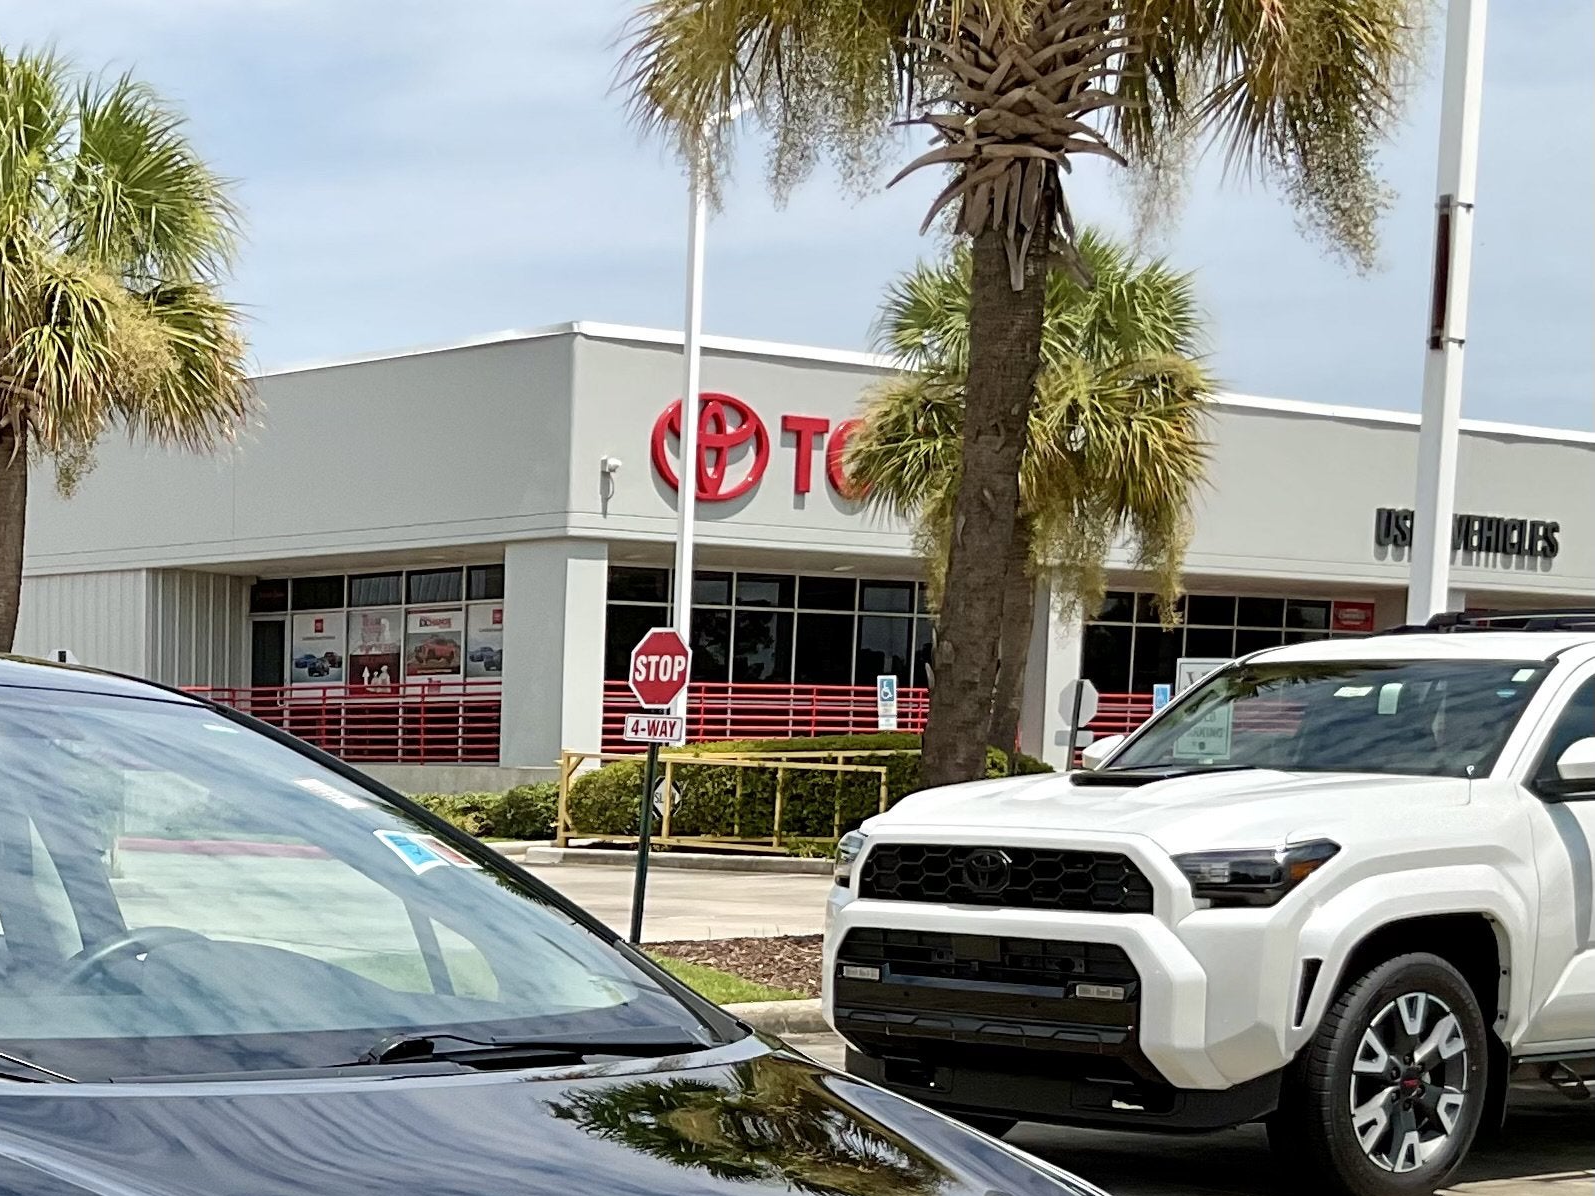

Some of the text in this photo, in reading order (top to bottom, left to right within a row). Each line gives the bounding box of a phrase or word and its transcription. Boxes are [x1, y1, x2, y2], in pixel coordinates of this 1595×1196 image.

[1375, 507, 1561, 558] US VEHICLES
[634, 655, 687, 682] STOP
[631, 719, 678, 738] 4-WAY
